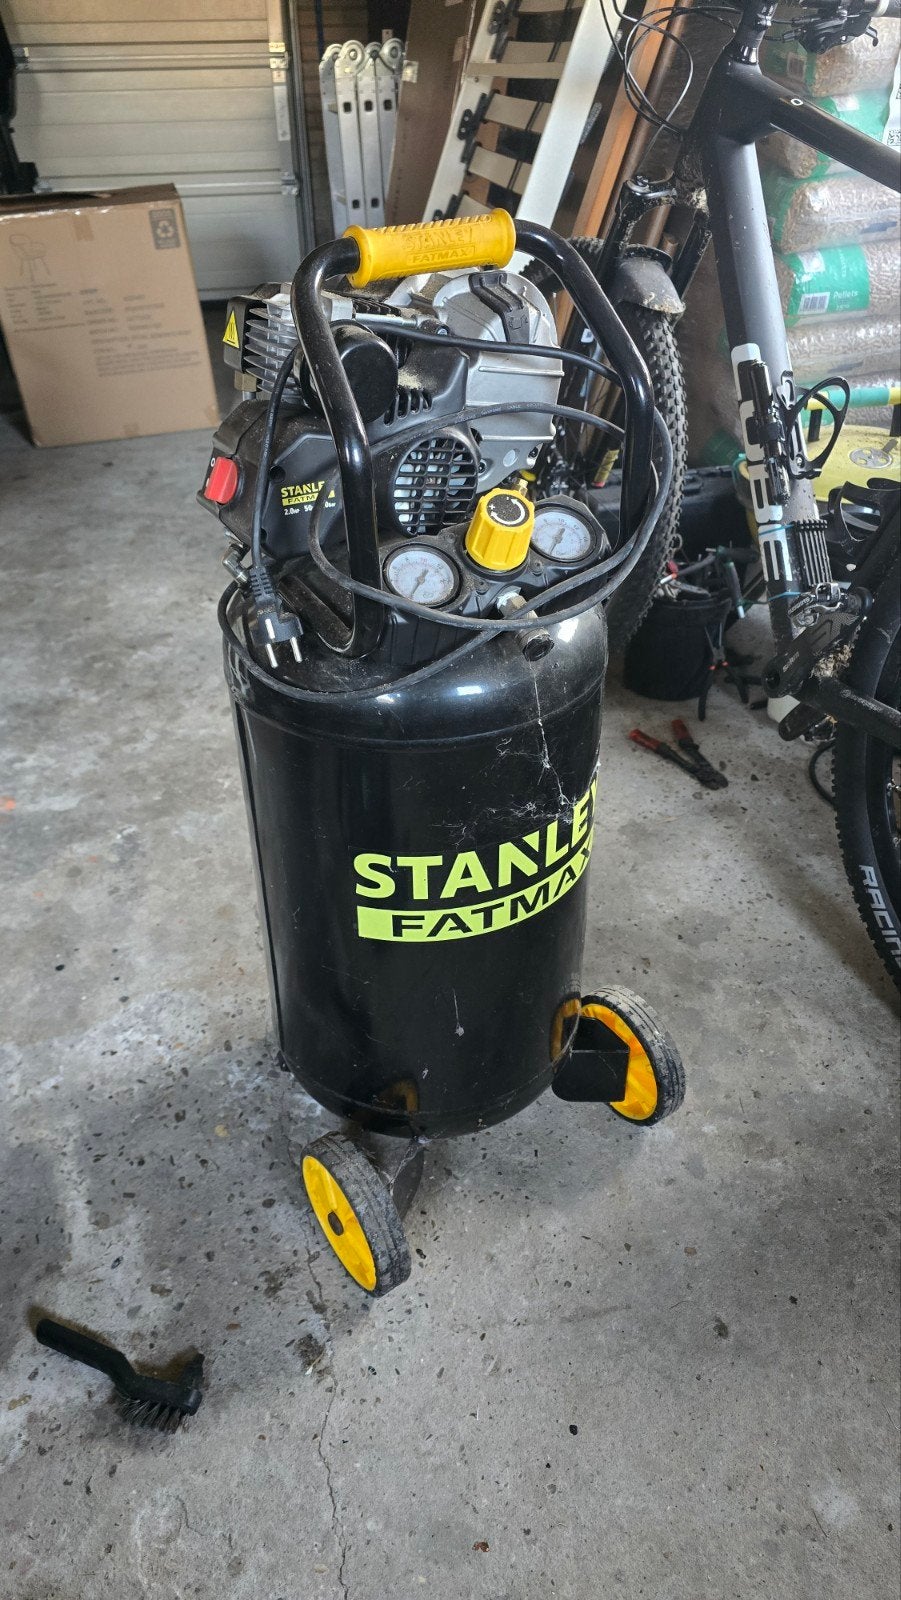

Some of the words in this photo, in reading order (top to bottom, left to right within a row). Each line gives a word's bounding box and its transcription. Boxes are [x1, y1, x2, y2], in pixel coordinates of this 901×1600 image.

[405, 227, 471, 250] STANLEY
[412, 248, 467, 263] FATMAX
[280, 481, 325, 498] STANLE
[391, 841, 591, 937] FATMAX
[859, 864, 901, 968] RACIN
